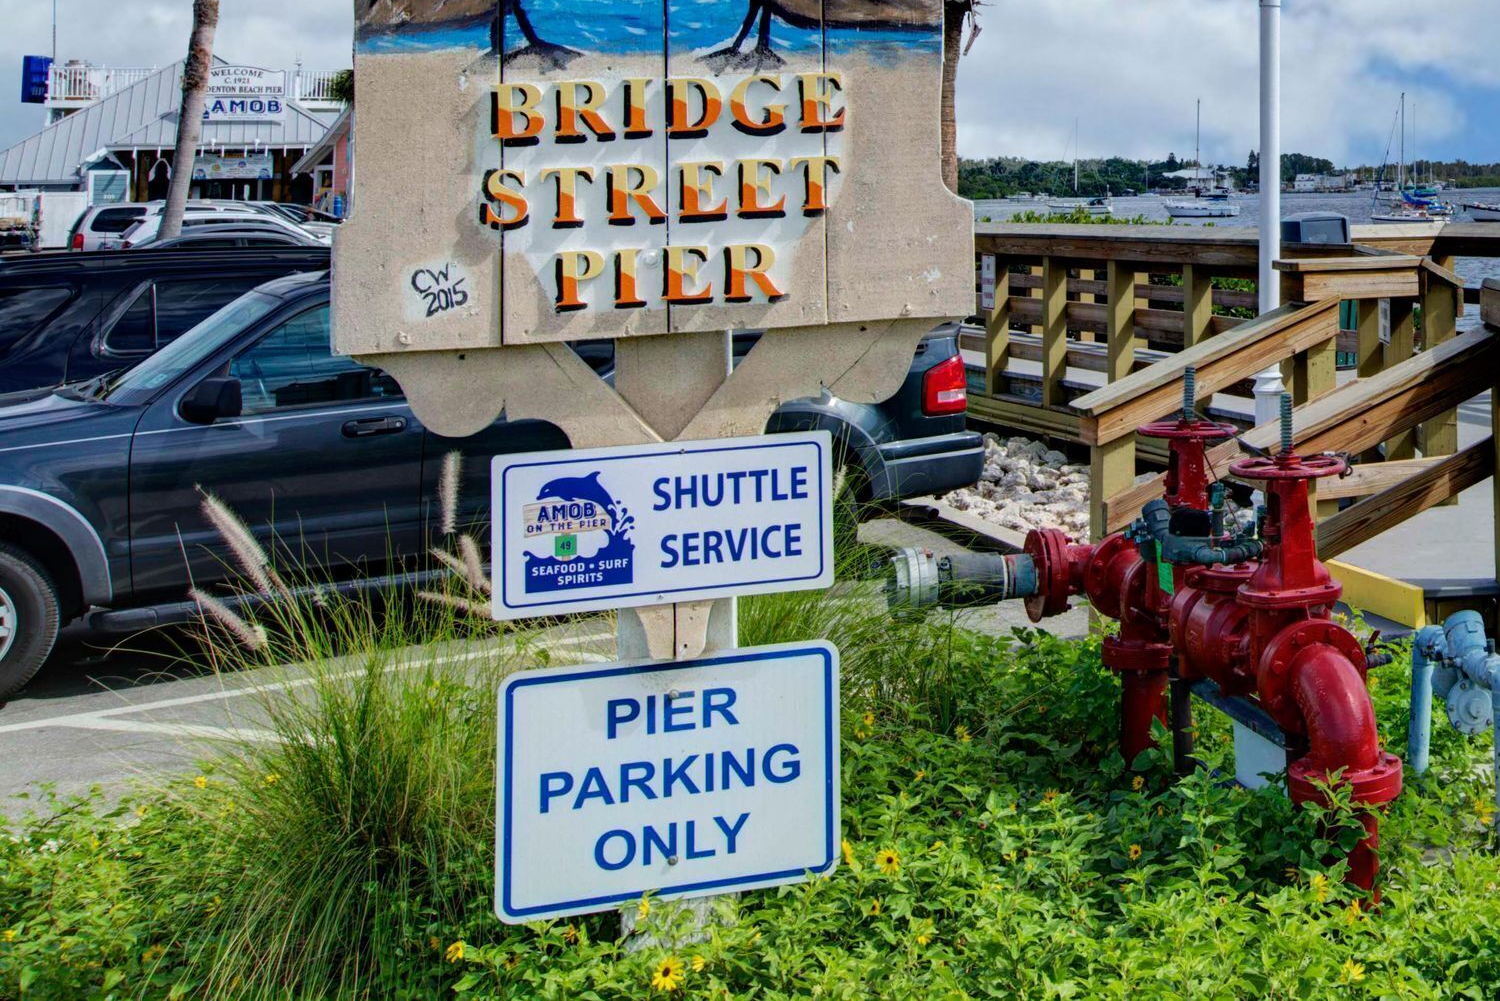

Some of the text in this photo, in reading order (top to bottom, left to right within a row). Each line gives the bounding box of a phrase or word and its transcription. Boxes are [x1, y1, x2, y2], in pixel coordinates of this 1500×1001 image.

[211, 69, 264, 78] WELCOME
[211, 100, 282, 113] AMOB
[490, 72, 846, 147] BRIDGE
[480, 156, 841, 230] STREET
[411, 262, 449, 294] CW
[422, 277, 468, 317] 2015
[555, 243, 790, 312] PIER
[653, 466, 808, 511] SHUTTLE
[527, 518, 607, 533] ON THE PIER
[537, 502, 597, 523] AMOB
[560, 541, 571, 550] 49
[660, 523, 802, 568] SERVICE
[532, 558, 629, 576] SEAFOOD SURF
[557, 572, 603, 585] SPIRITS
[607, 687, 740, 739] PIER
[539, 743, 801, 814] PARKING
[594, 812, 751, 871] ONLY
